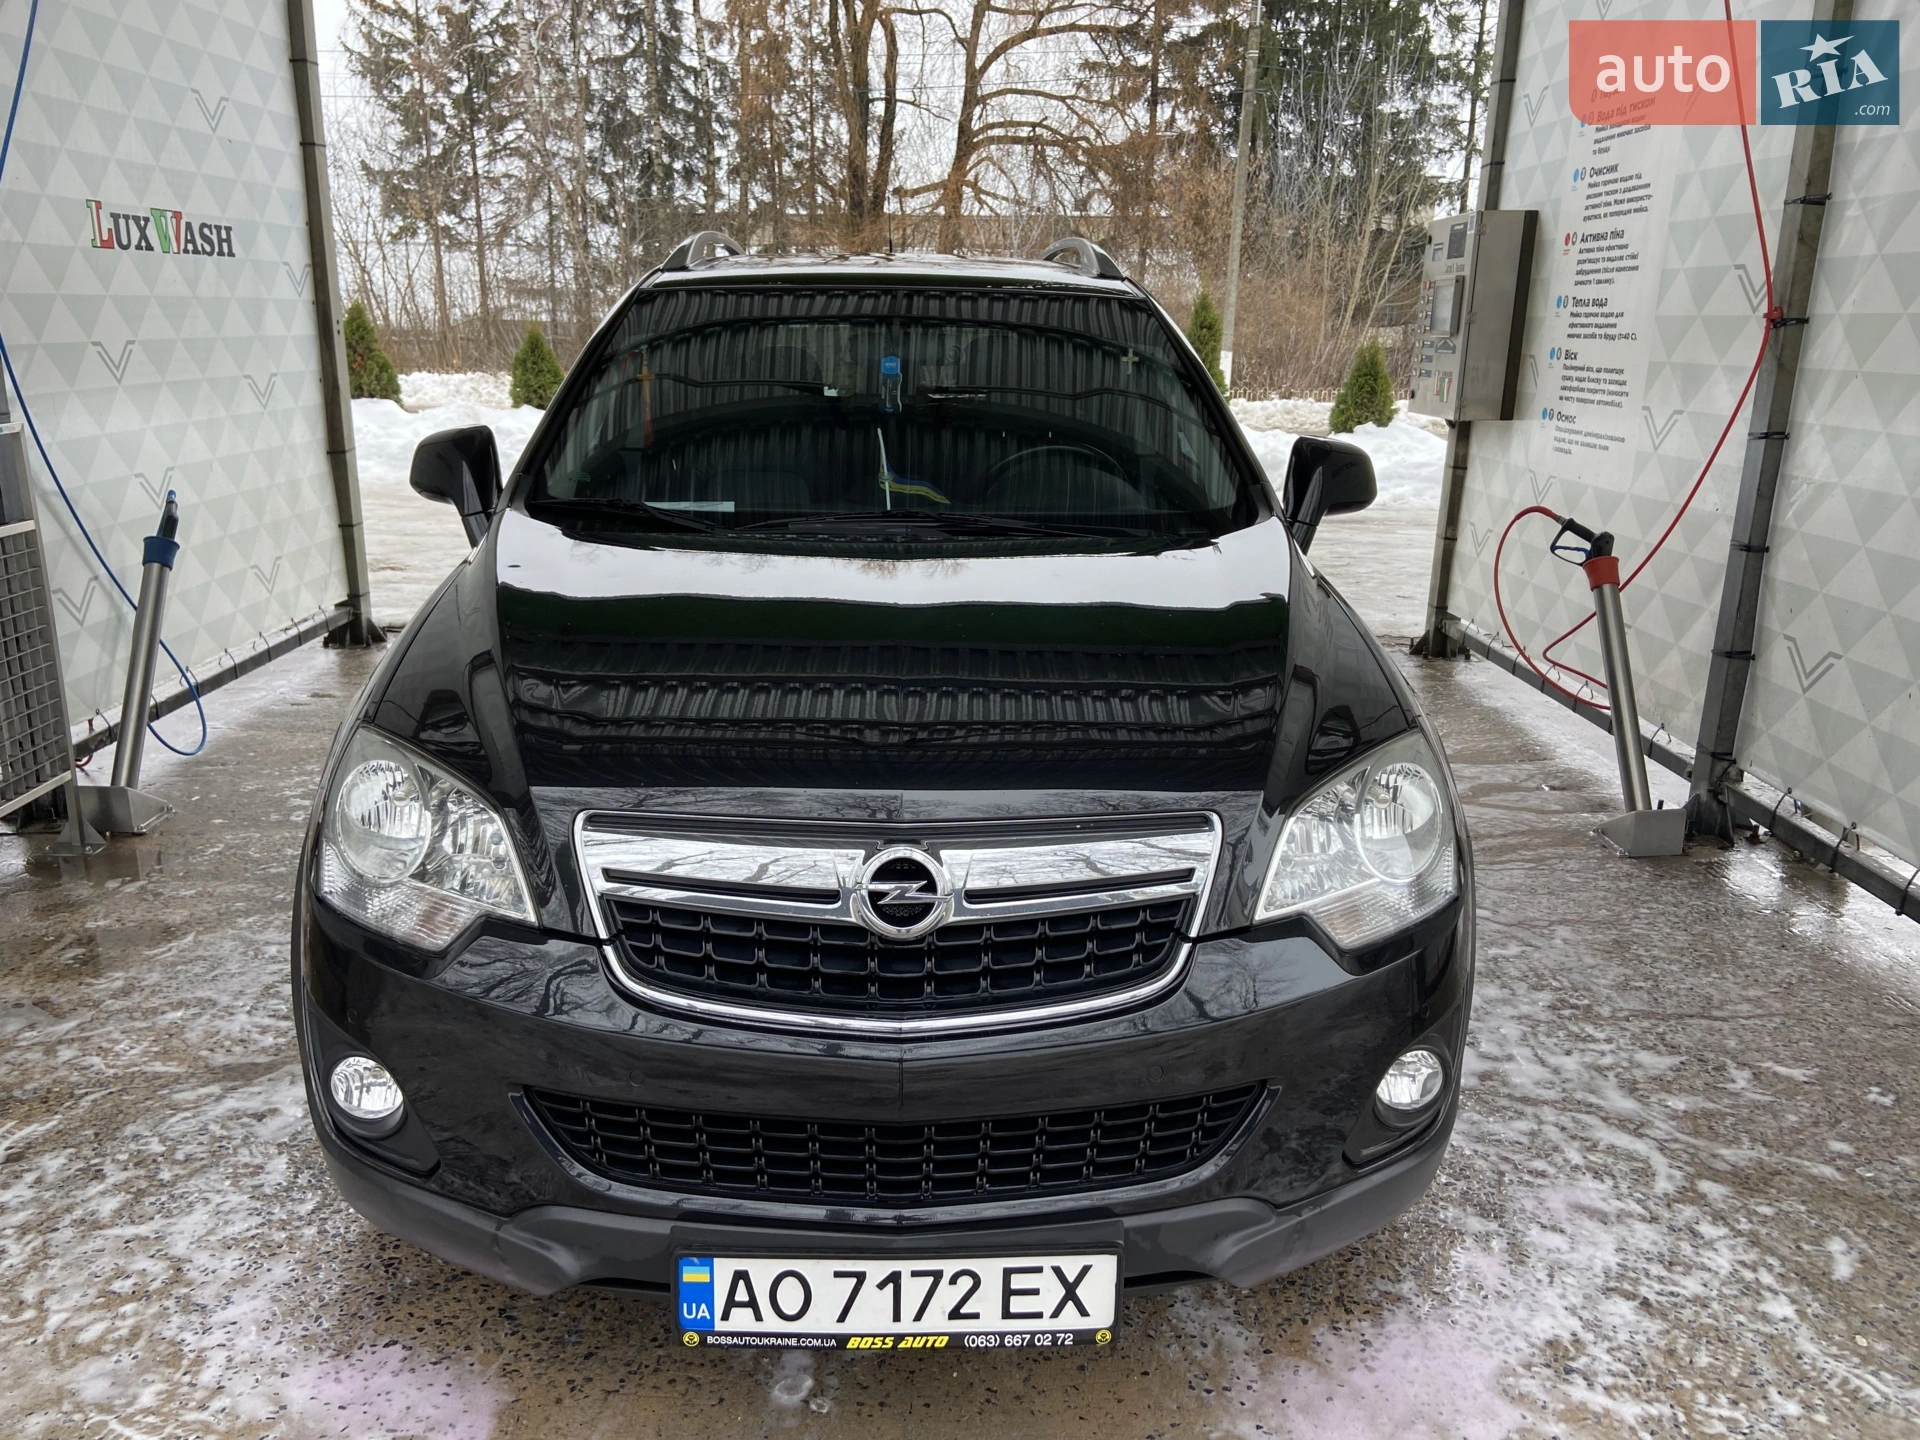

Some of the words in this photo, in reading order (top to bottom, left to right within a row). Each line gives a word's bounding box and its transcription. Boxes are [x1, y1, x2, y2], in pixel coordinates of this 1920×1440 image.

[1597, 109, 1614, 122] Вода
[1616, 103, 1626, 117] під
[1630, 97, 1656, 112] тиском
[1590, 163, 1619, 178] Очисник
[1588, 180, 1600, 189] Мийка
[1601, 178, 1618, 187] гарячою
[1622, 183, 1651, 194] додаванням
[1614, 197, 1625, 205] Може
[1580, 232, 1608, 243] Активна
[1610, 228, 1624, 240] піна
[1605, 244, 1629, 252] ефективно
[1572, 297, 1590, 307] Тепла
[1592, 298, 1608, 308] вода
[1604, 332, 1617, 340] бруду
[1565, 349, 1578, 360] Віск
[1557, 412, 1576, 424] Осмос
[683, 1303, 710, 1319] UA
[721, 1269, 812, 1322] AO
[833, 1269, 981, 1323] 7172
[1001, 1264, 1093, 1320] EX
[707, 1336, 836, 1346] BOSSAUTOUKRAINE.COM.UA
[847, 1336, 894, 1348] BOSS
[898, 1336, 949, 1348] AUTO
[964, 1335, 999, 1347] (063)
[1005, 1334, 1030, 1346] 667
[1035, 1334, 1052, 1346] 02
[1057, 1333, 1073, 1345] 72
